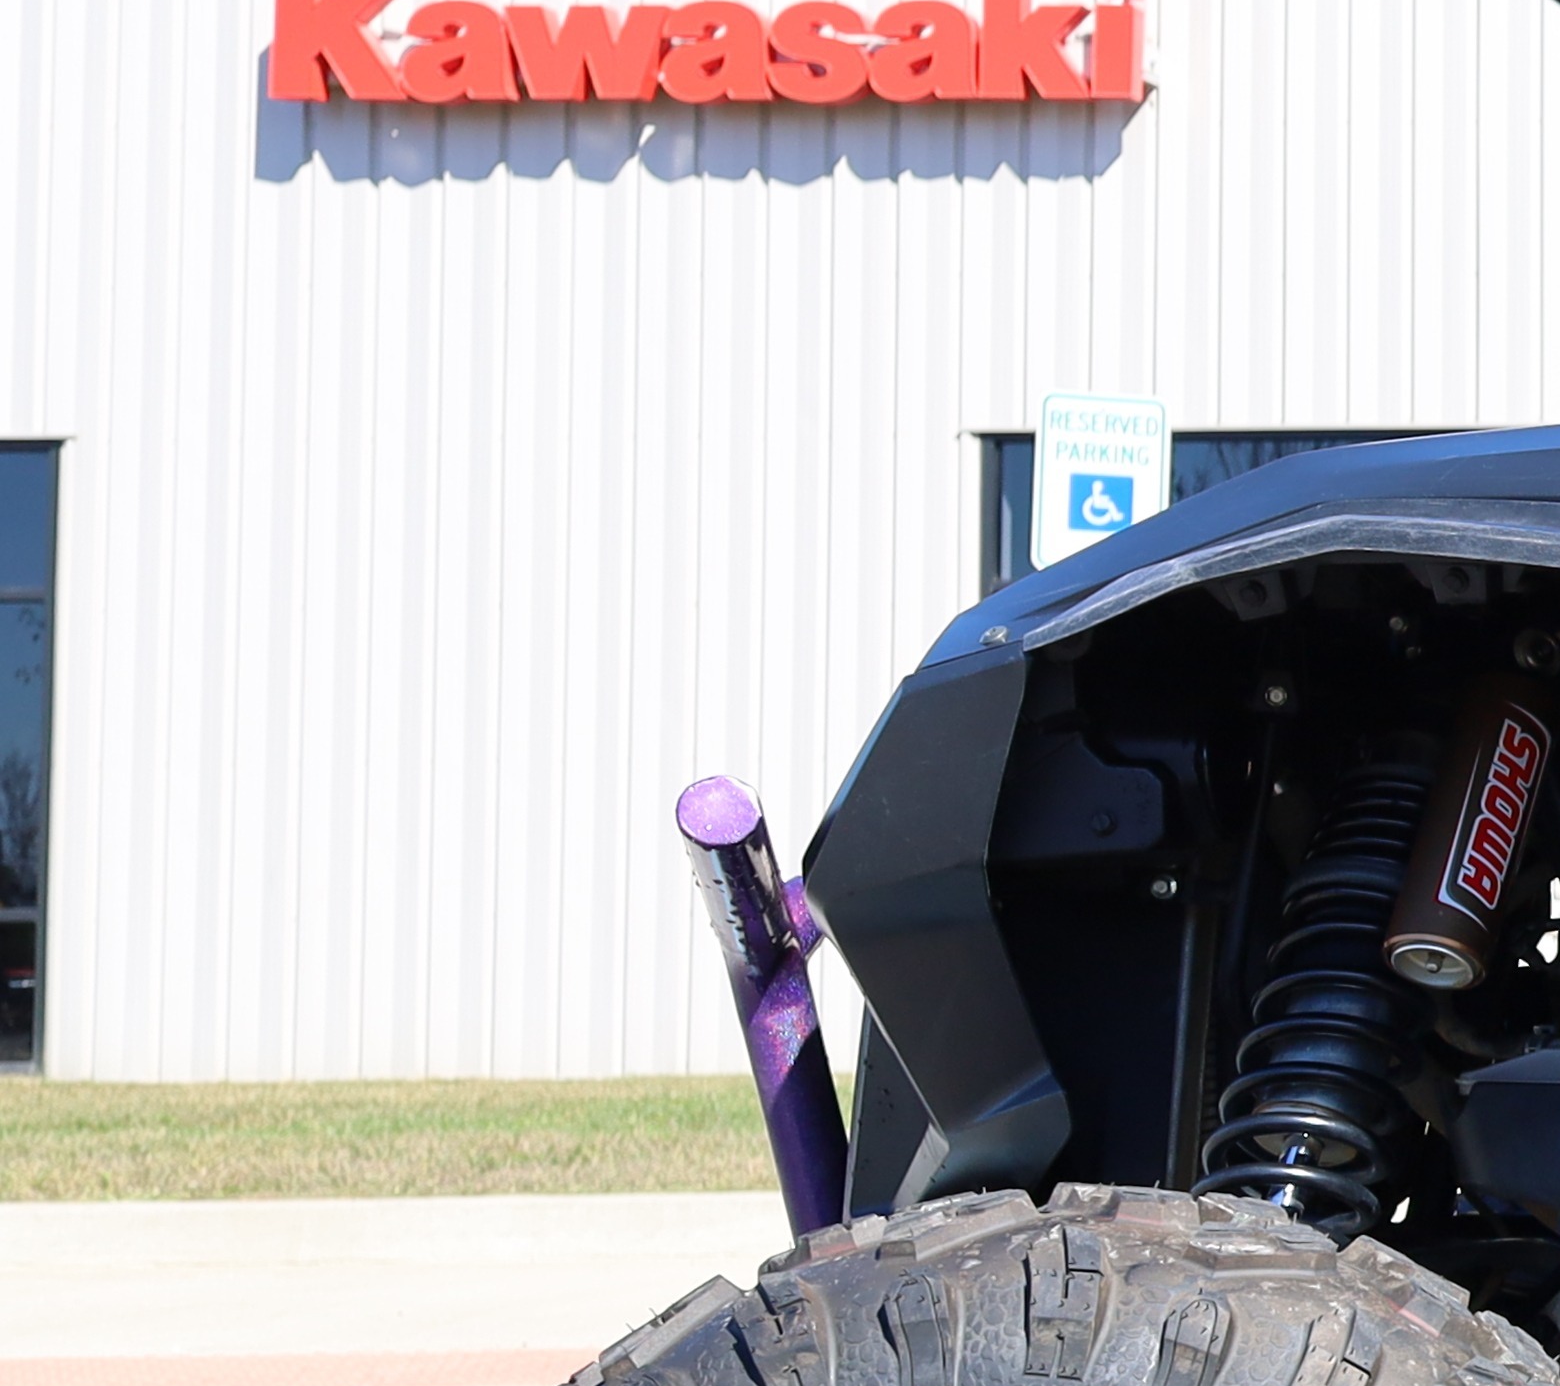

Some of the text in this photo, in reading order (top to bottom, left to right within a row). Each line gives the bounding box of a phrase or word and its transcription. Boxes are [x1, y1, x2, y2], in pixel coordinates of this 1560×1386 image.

[1050, 410, 1158, 437] RESERVED
[1055, 440, 1149, 466] PARKING
[1457, 717, 1540, 911] SHOWA
